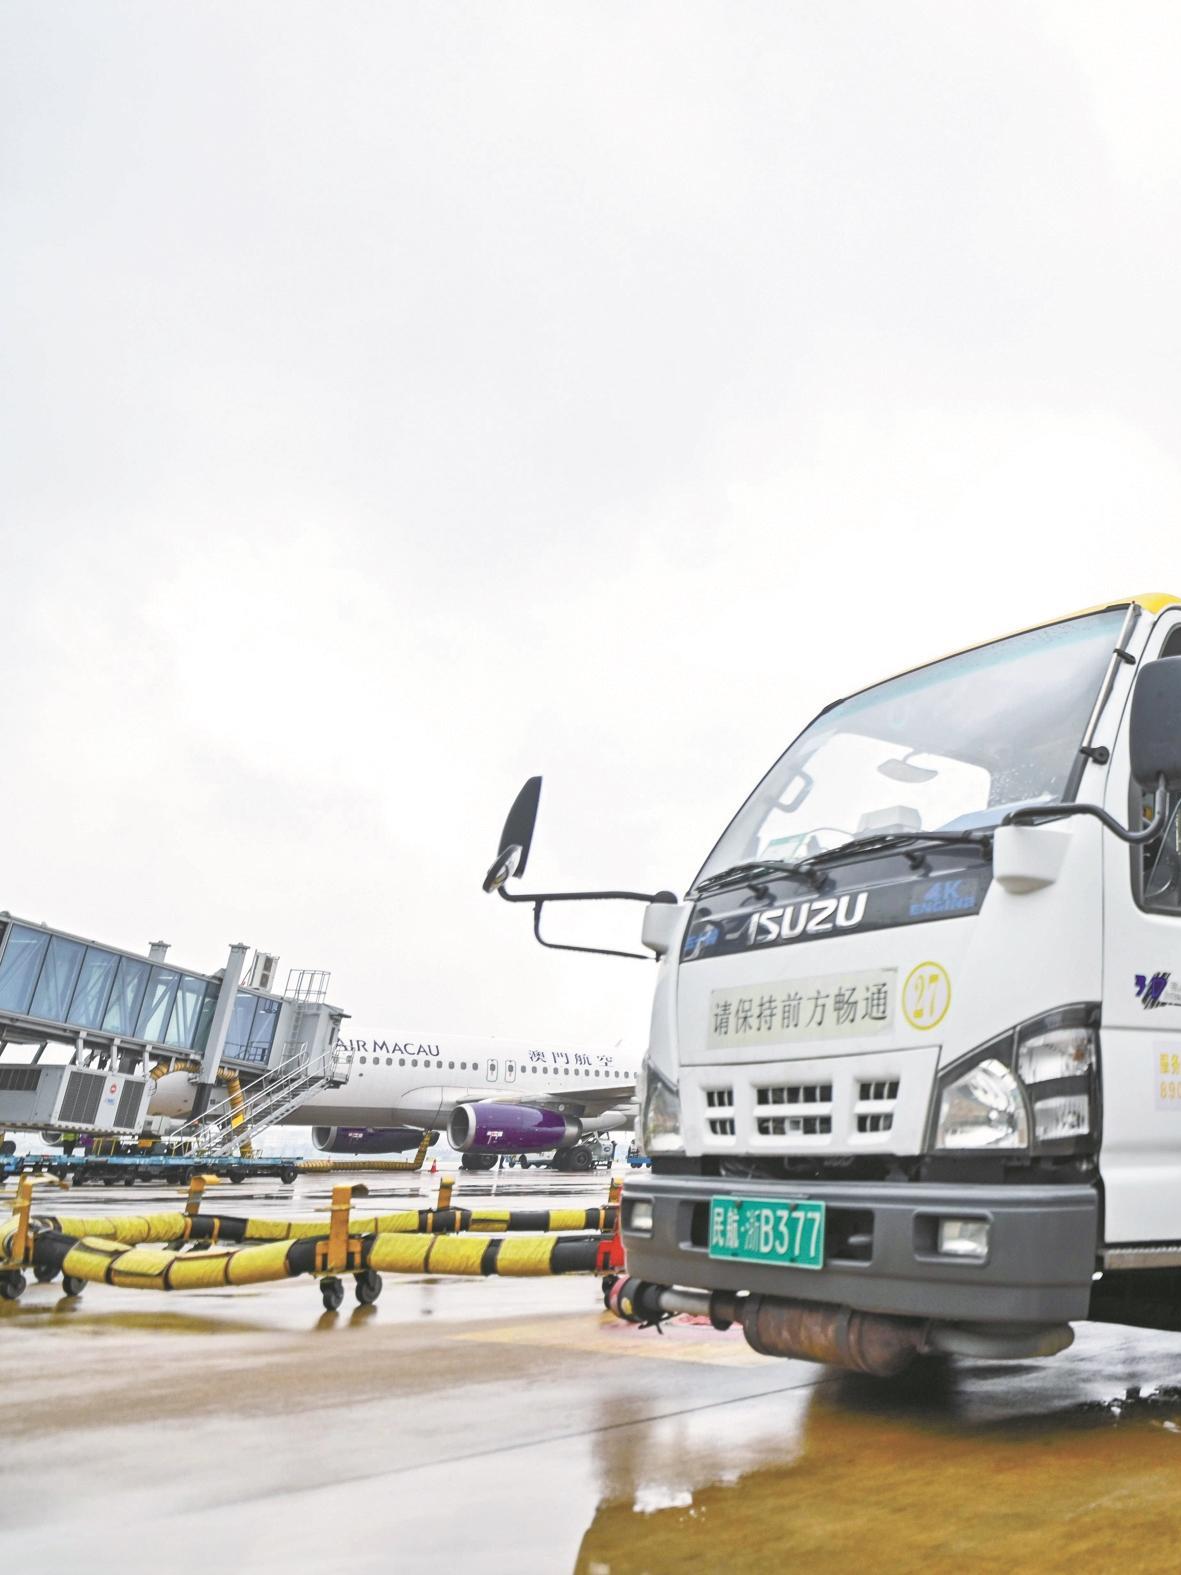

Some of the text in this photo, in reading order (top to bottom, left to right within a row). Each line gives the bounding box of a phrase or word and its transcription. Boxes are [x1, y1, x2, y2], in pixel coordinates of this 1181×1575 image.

[923, 880, 962, 899] 4K
[746, 892, 868, 945] ISUZU
[713, 982, 888, 1035] 请保持前方畅通
[913, 974, 939, 1019] 27
[373, 1040, 440, 1057] MACAU
